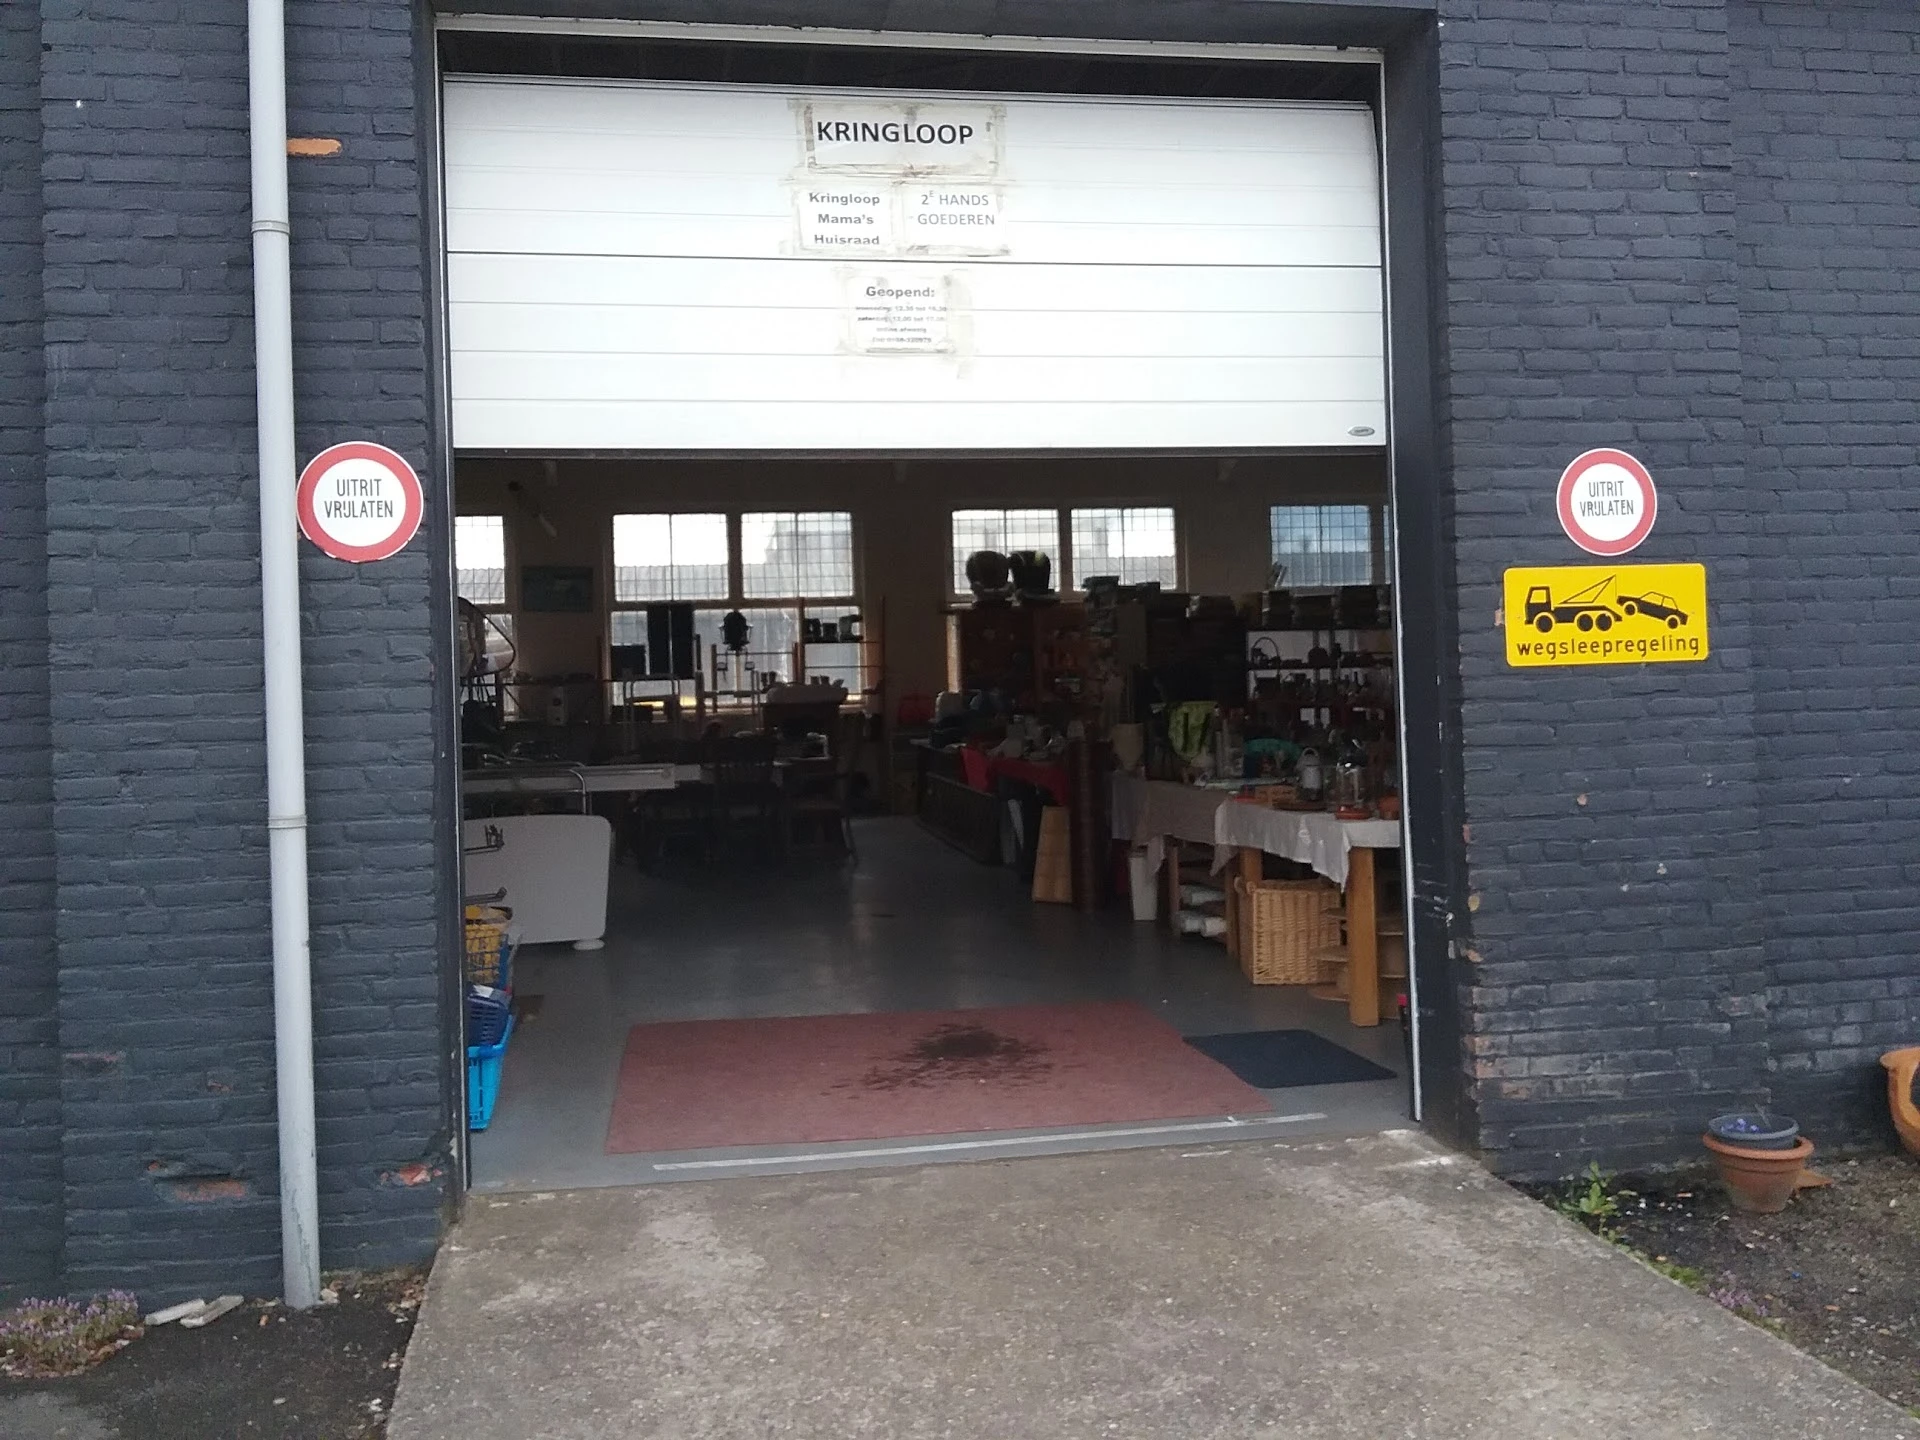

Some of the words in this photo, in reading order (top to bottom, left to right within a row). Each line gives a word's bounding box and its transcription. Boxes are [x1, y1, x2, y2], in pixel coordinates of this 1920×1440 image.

[816, 121, 974, 145] KRINGLOOP
[808, 191, 880, 206] Kringloop
[939, 193, 989, 207] HANDS
[817, 213, 874, 225] Mama's
[917, 213, 995, 226] GOEDEREN
[814, 234, 880, 245] Huisraad
[866, 286, 935, 299] Geopend:
[336, 478, 382, 497] UITRIT
[1588, 480, 1624, 498] UITRIT
[324, 500, 394, 518] VRIJLATEN
[1579, 499, 1635, 517] VRIJLATEN
[1516, 635, 1699, 661] wegsleepregeling
